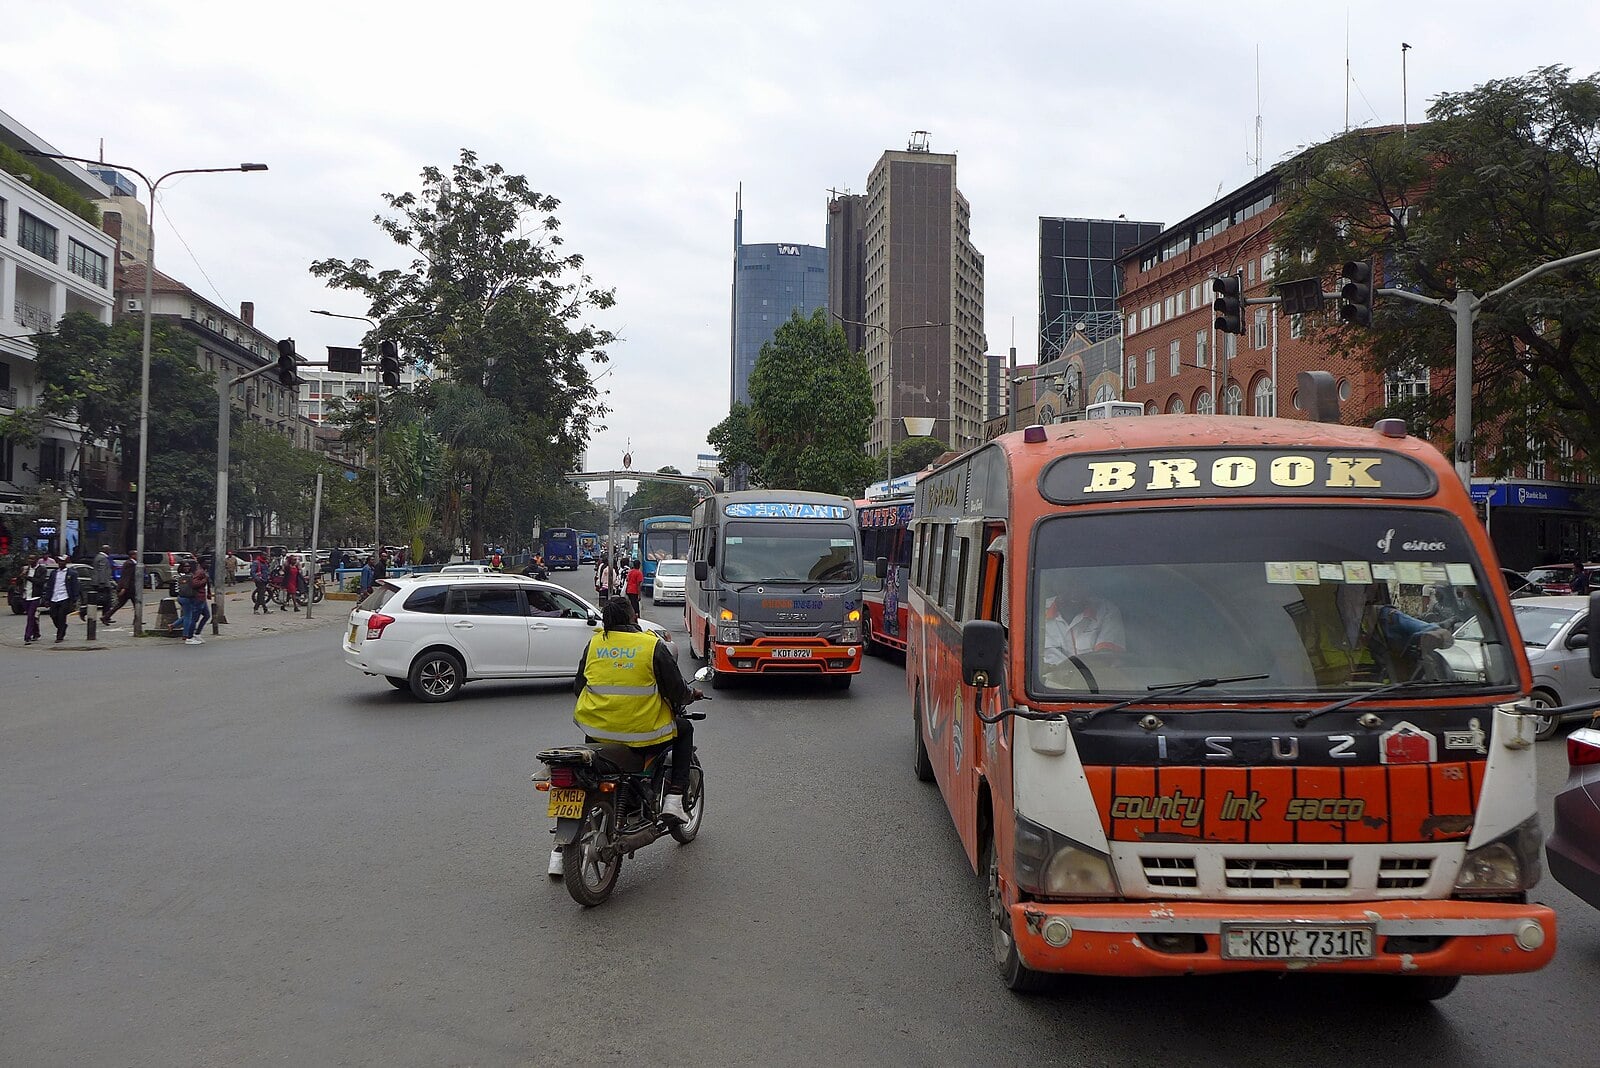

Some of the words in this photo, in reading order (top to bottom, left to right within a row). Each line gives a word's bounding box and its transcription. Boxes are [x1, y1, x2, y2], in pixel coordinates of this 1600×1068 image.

[1083, 455, 1382, 493] BROOK
[40, 527, 56, 535] oppo
[1377, 528, 1396, 554] of
[1110, 790, 1204, 827] county
[1219, 791, 1265, 821] link
[1284, 798, 1364, 821] sacco
[1250, 930, 1295, 956] KBY
[1306, 930, 1364, 956] 731R
